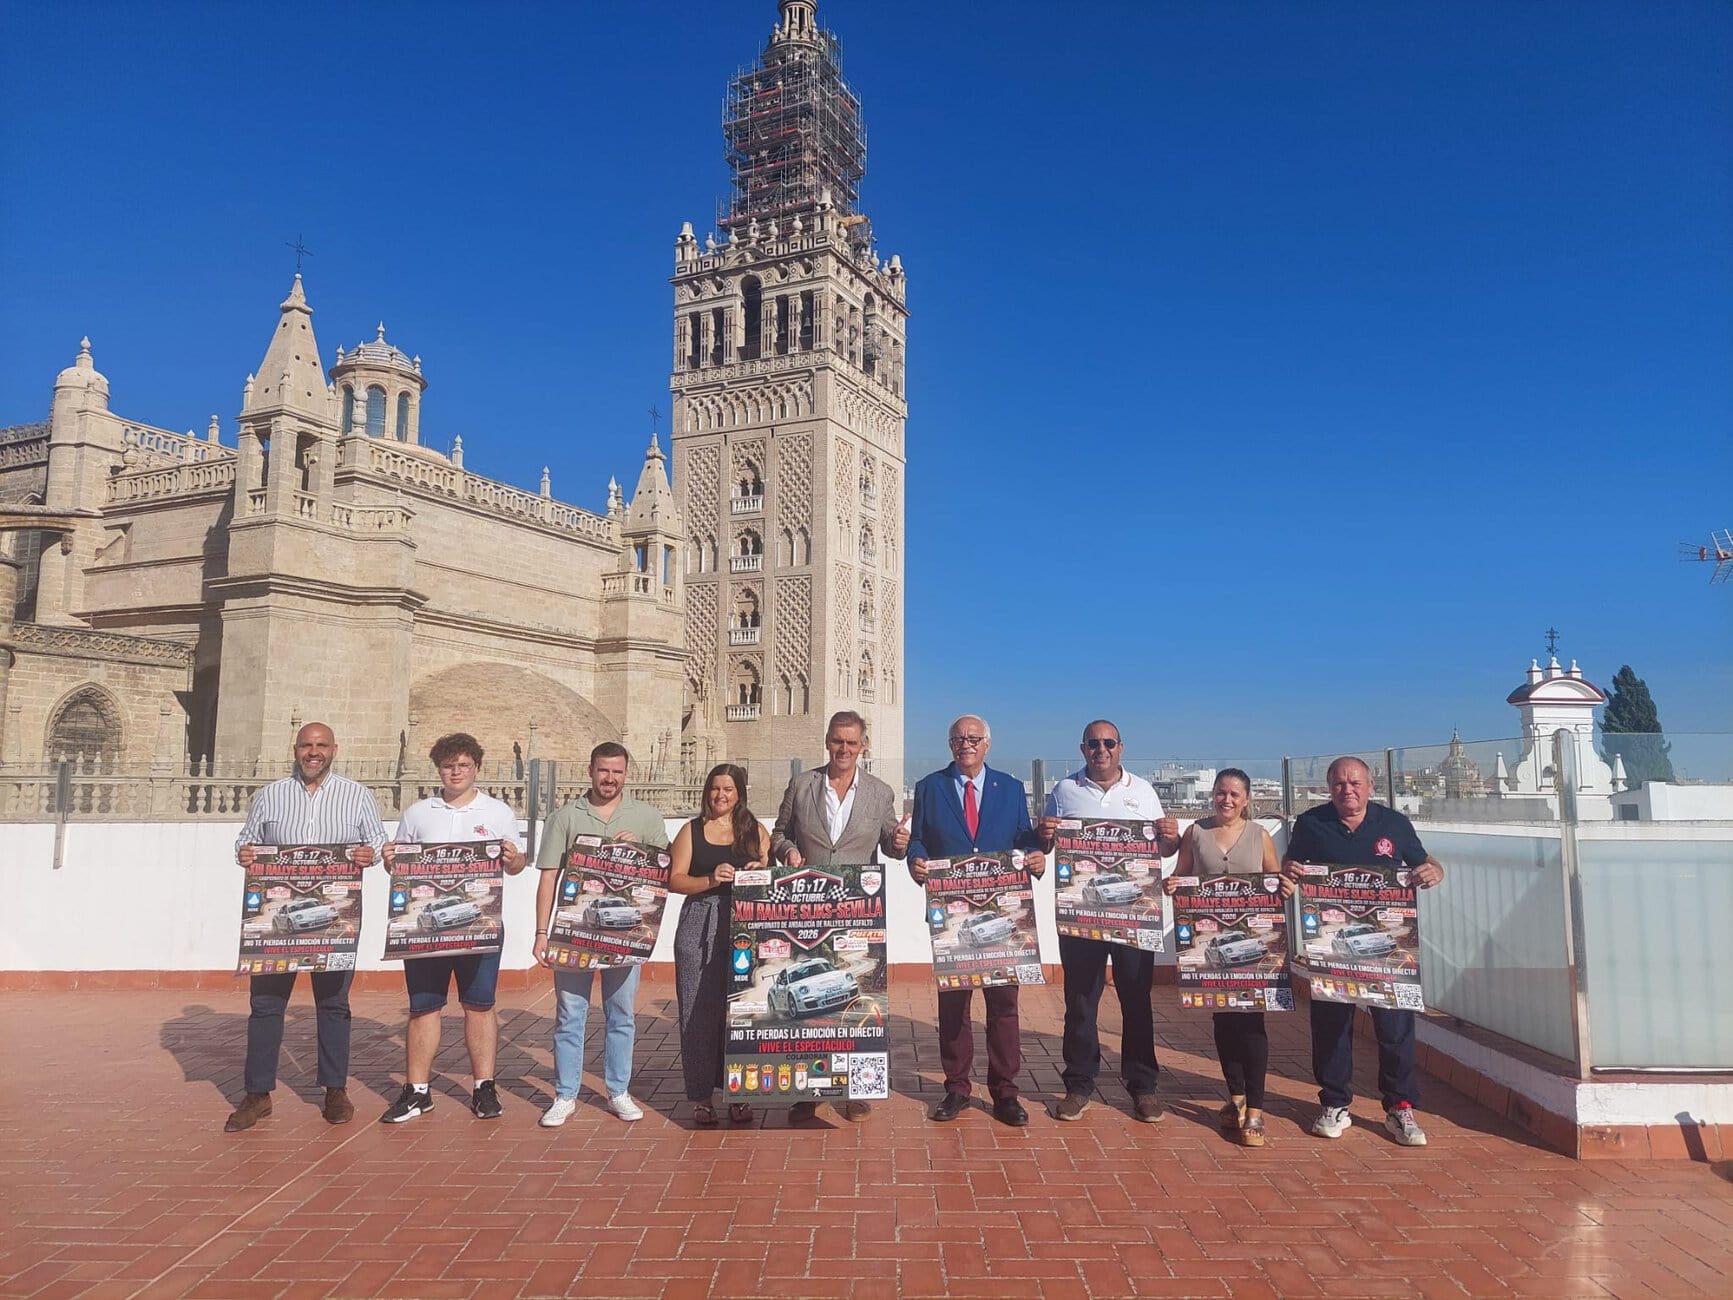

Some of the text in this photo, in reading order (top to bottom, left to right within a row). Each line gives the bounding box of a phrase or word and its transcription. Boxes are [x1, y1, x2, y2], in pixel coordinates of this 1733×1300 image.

[1073, 840, 1100, 851] RALLYE
[612, 848, 620, 856] 16
[626, 850, 636, 858] 17
[410, 863, 440, 874] RALLYE
[586, 856, 614, 871] RALLYE
[980, 862, 989, 870] 17
[266, 865, 296, 875] RALLYE
[1344, 873, 1354, 882] 16
[1360, 874, 1370, 882] 17
[792, 879, 804, 892] 16
[813, 878, 827, 890] 17
[943, 878, 971, 889] RALLYE
[792, 893, 826, 902] OCTUBRE
[1318, 886, 1350, 898] RALLYE
[1191, 897, 1220, 907] RALLYE
[757, 903, 797, 920] RALLYE
[798, 930, 818, 939] 2026
[731, 1027, 884, 1040] ¡NO TE PIERDAS LA EMOCIÓN EN DIRECTO!
[759, 1042, 780, 1053] ¡VIVE
[783, 1041, 792, 1052] EL
